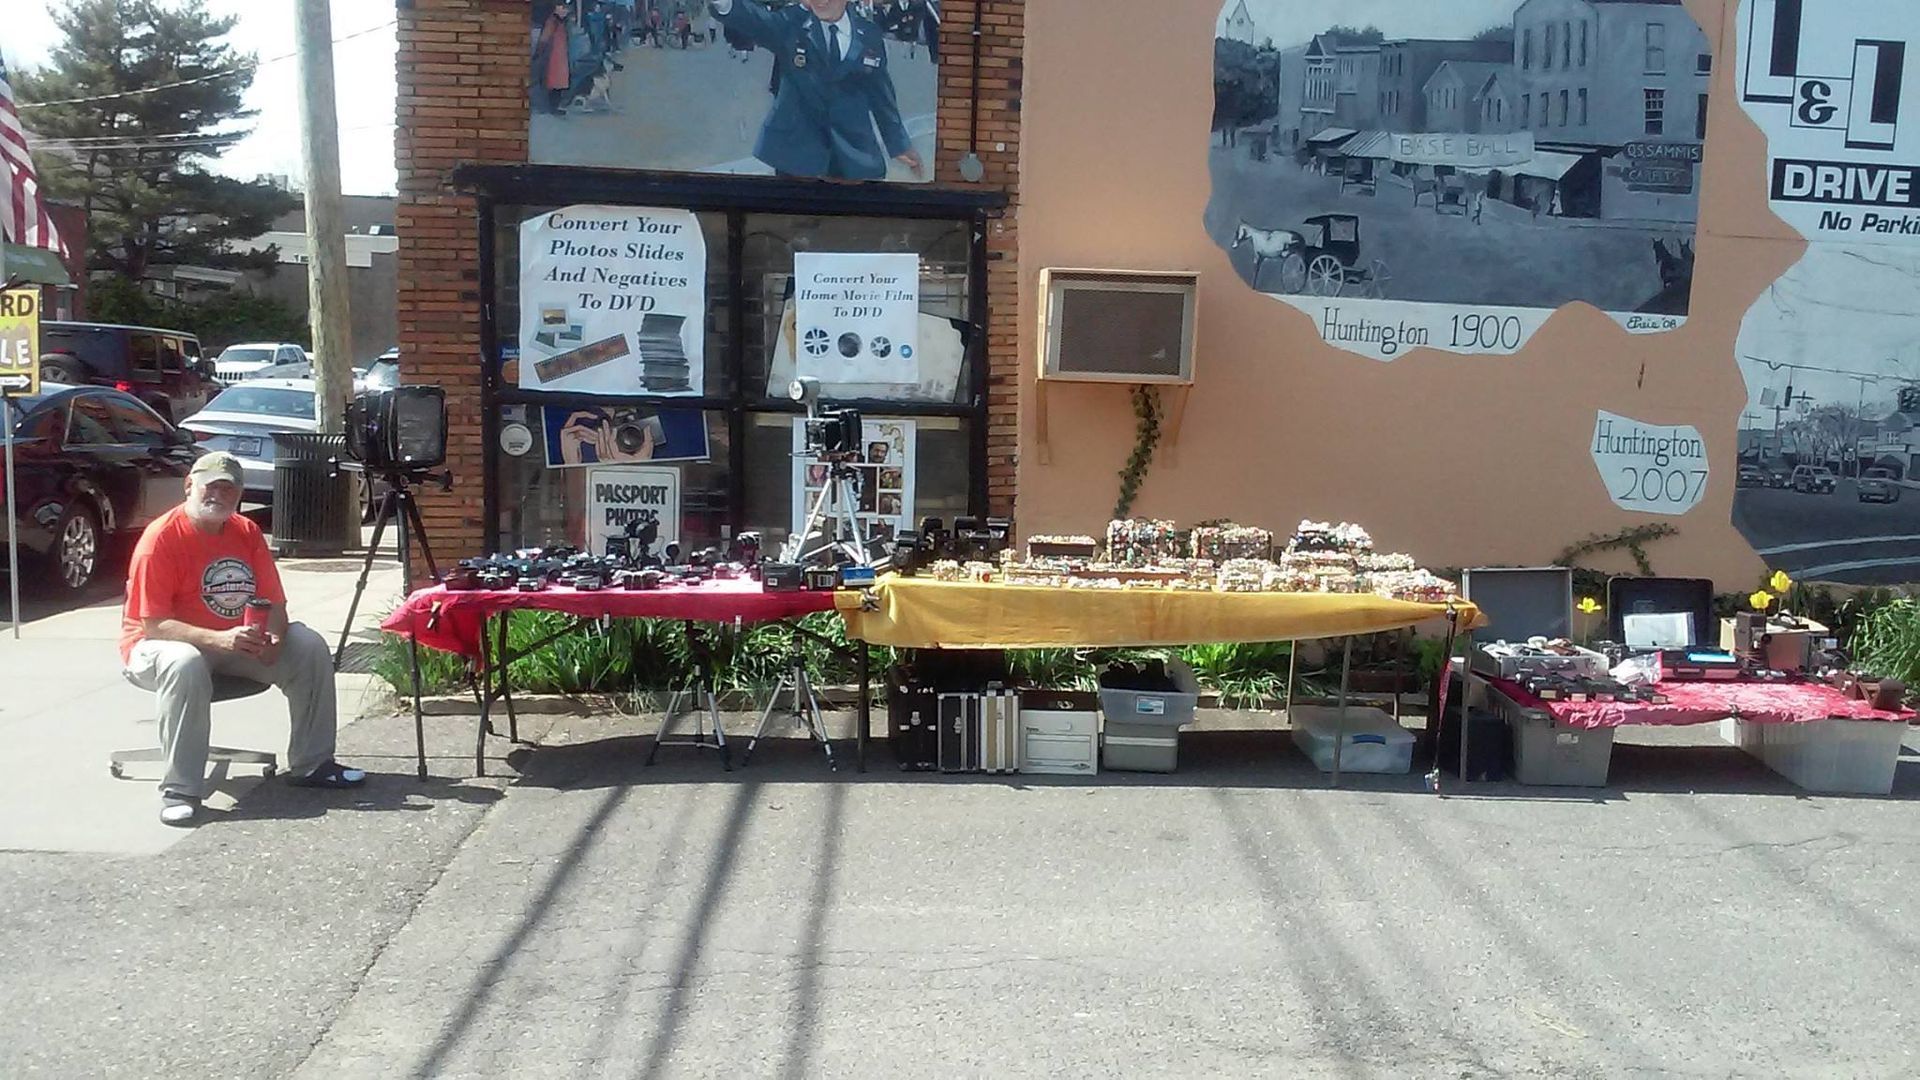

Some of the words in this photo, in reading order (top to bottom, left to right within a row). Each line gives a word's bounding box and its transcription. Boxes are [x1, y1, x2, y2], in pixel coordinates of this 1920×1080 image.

[1400, 138, 1454, 156] BASE
[1466, 138, 1518, 157] BALL
[1783, 164, 1912, 203] DRIVE
[548, 213, 629, 232] Convert
[637, 216, 682, 234] Your
[1819, 210, 1852, 231] No
[1860, 212, 1920, 235] Parki
[550, 240, 618, 258] Photos
[624, 243, 684, 261] Slides
[544, 266, 586, 283] And
[592, 267, 688, 289] Negatives
[813, 272, 864, 284] Convert
[870, 273, 898, 284] Your
[578, 292, 602, 310] To
[609, 294, 655, 312] DVD
[800, 289, 837, 300] Home
[844, 290, 880, 301] Movie
[885, 289, 914, 301] Film
[833, 306, 848, 318] To
[852, 306, 883, 318] DVD
[1322, 307, 1429, 355] Huntington
[1450, 314, 1521, 349] 1900
[1595, 419, 1703, 467] Huntington
[595, 483, 668, 505] PASSPORT
[1617, 467, 1708, 503] 2007
